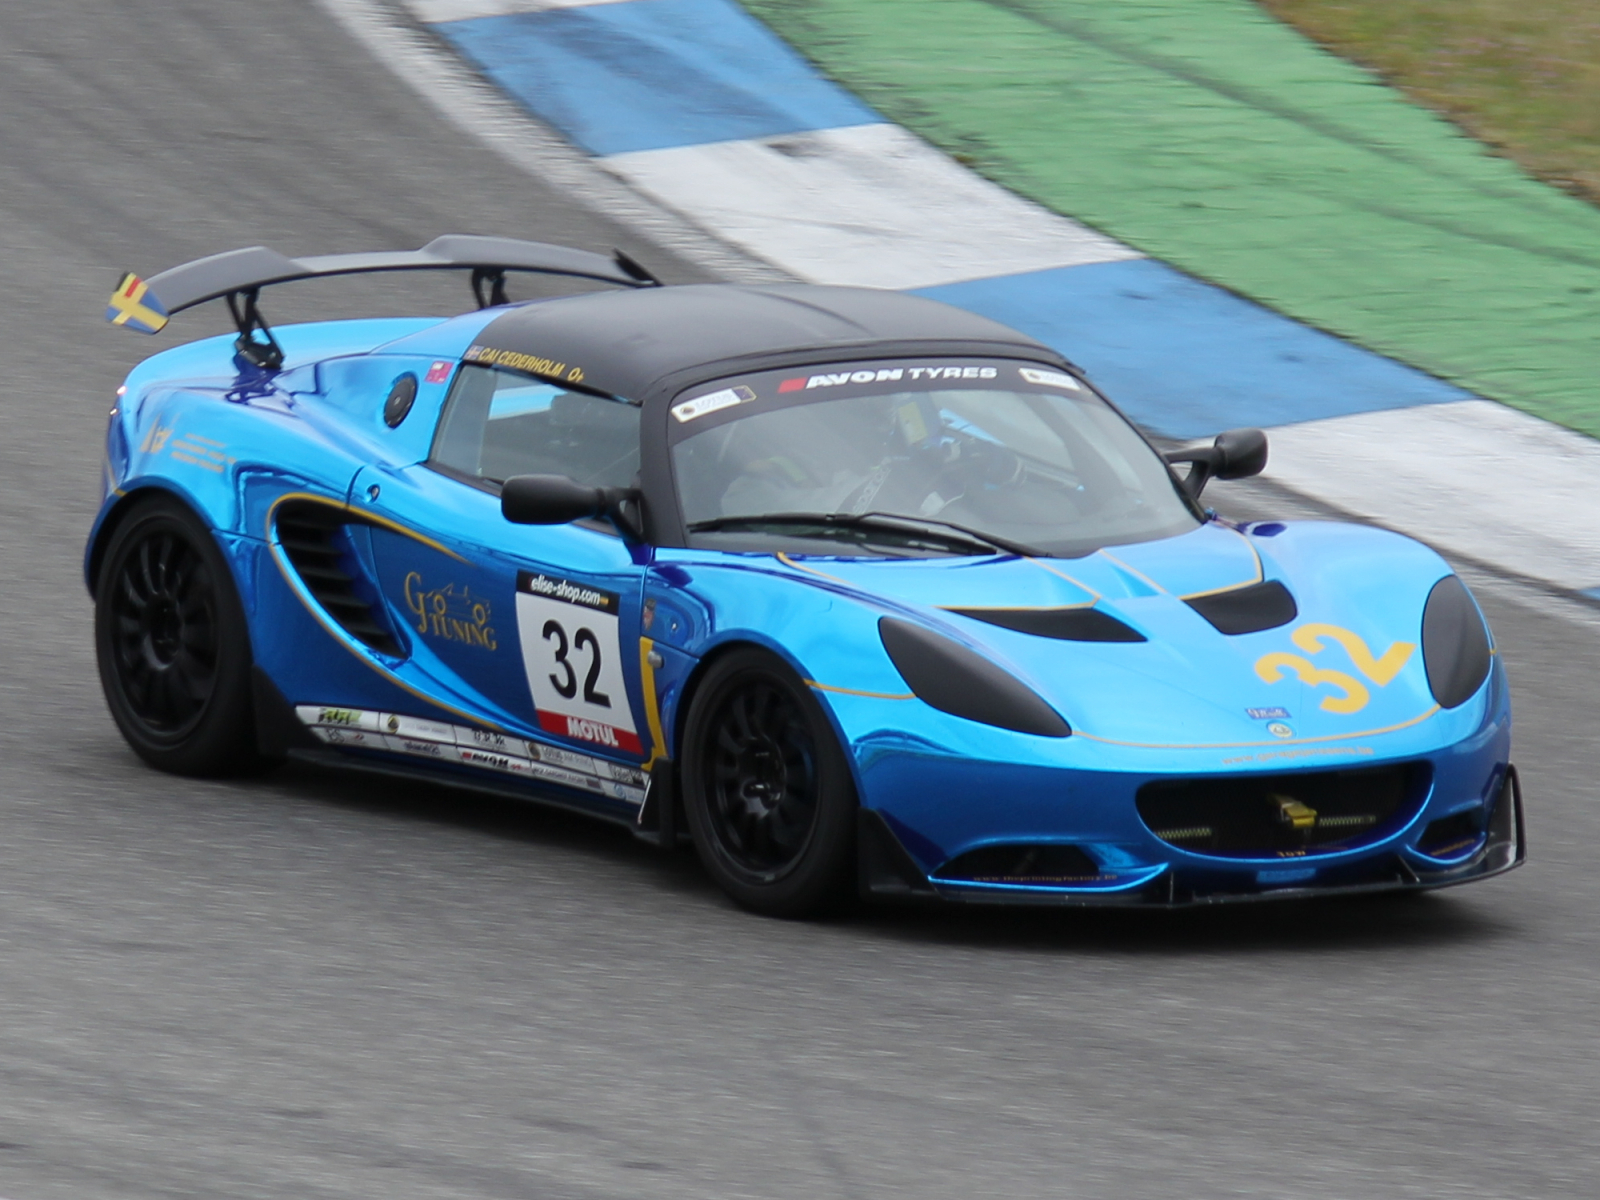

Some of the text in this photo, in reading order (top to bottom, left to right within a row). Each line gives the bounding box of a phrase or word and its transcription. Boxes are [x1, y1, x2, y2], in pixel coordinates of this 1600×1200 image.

[500, 351, 566, 377] CEDERHOLM
[806, 366, 998, 389] AVON TYRES
[531, 574, 600, 606] elise-shop.com
[543, 619, 612, 709] 32
[1254, 622, 1418, 715] 32
[567, 716, 619, 748] MOTUL
